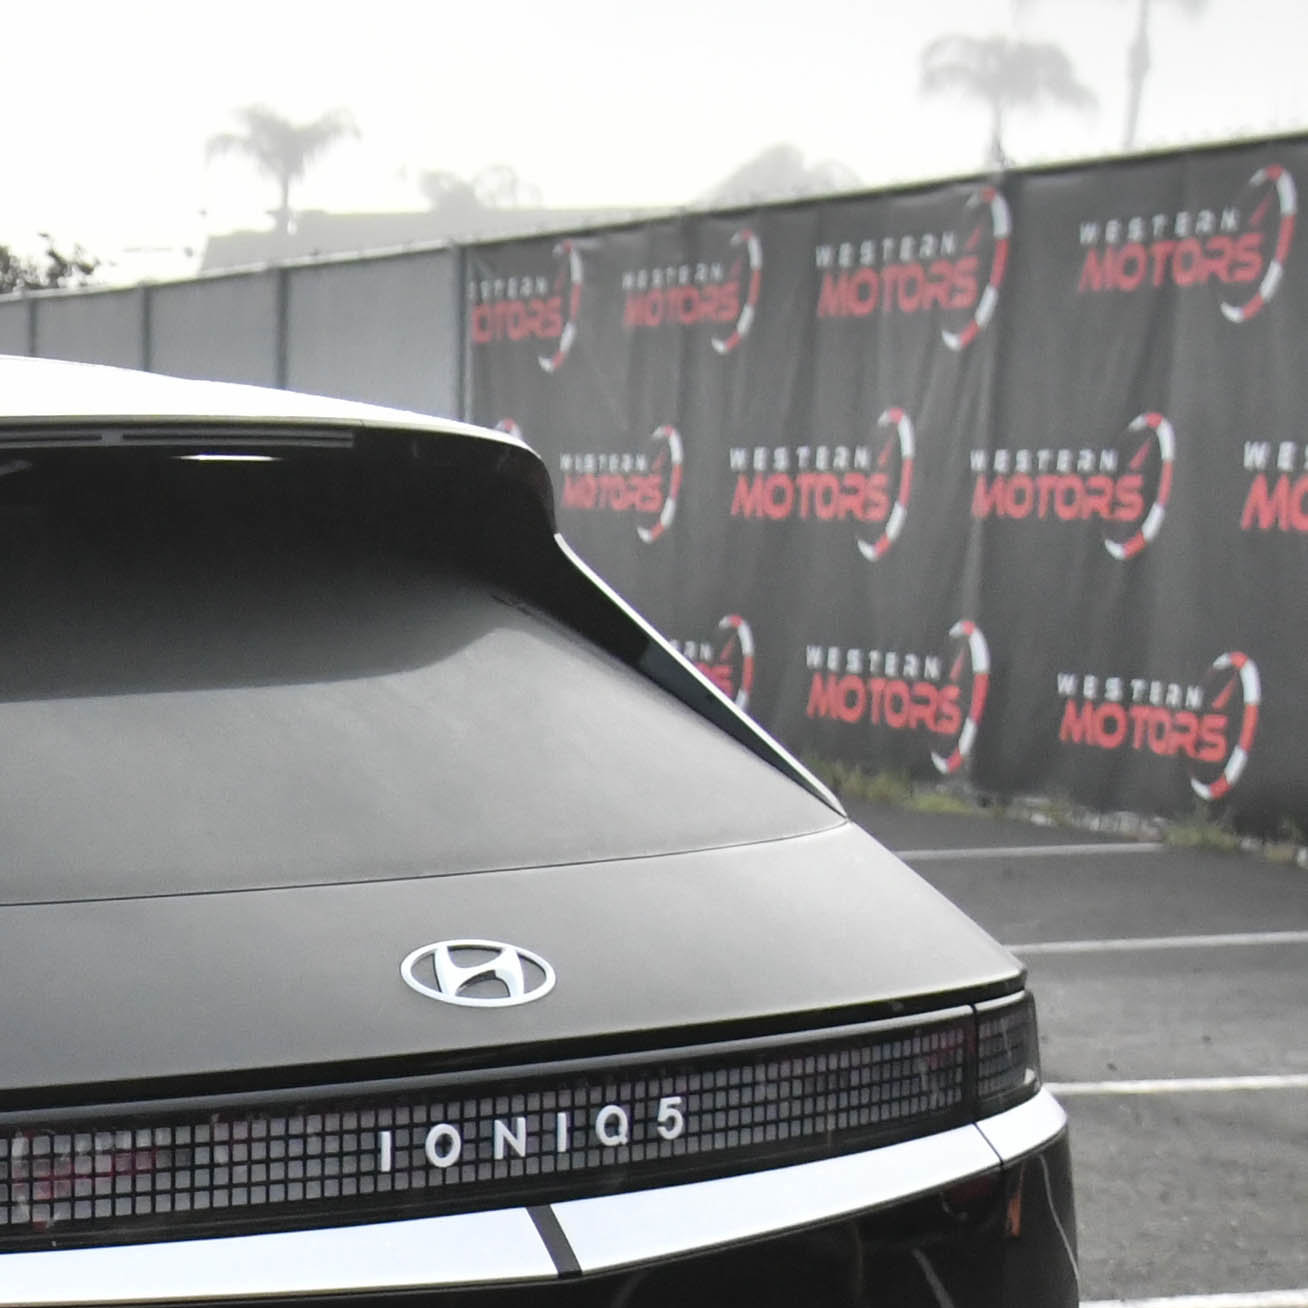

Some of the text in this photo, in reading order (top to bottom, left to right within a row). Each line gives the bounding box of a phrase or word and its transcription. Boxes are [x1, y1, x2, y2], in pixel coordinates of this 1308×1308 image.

[1080, 210, 1236, 244] WESTERN
[817, 234, 955, 267] WESTERN
[1080, 232, 1264, 292] MOTORS
[623, 265, 720, 289] WESTERN
[818, 257, 979, 317] MOTORS
[472, 296, 562, 344] OTORS
[624, 281, 740, 326] MOTORS
[730, 446, 869, 470] WESTERN
[971, 450, 1115, 472] WESTERN
[563, 472, 664, 512] MOTORS
[731, 472, 890, 522] MOTORS
[972, 473, 1146, 522] MOTORS
[807, 646, 939, 678] WESTERN
[806, 673, 962, 735] MOTORS
[1058, 674, 1202, 709] WESTERN
[1059, 697, 1230, 763] MOTORS
